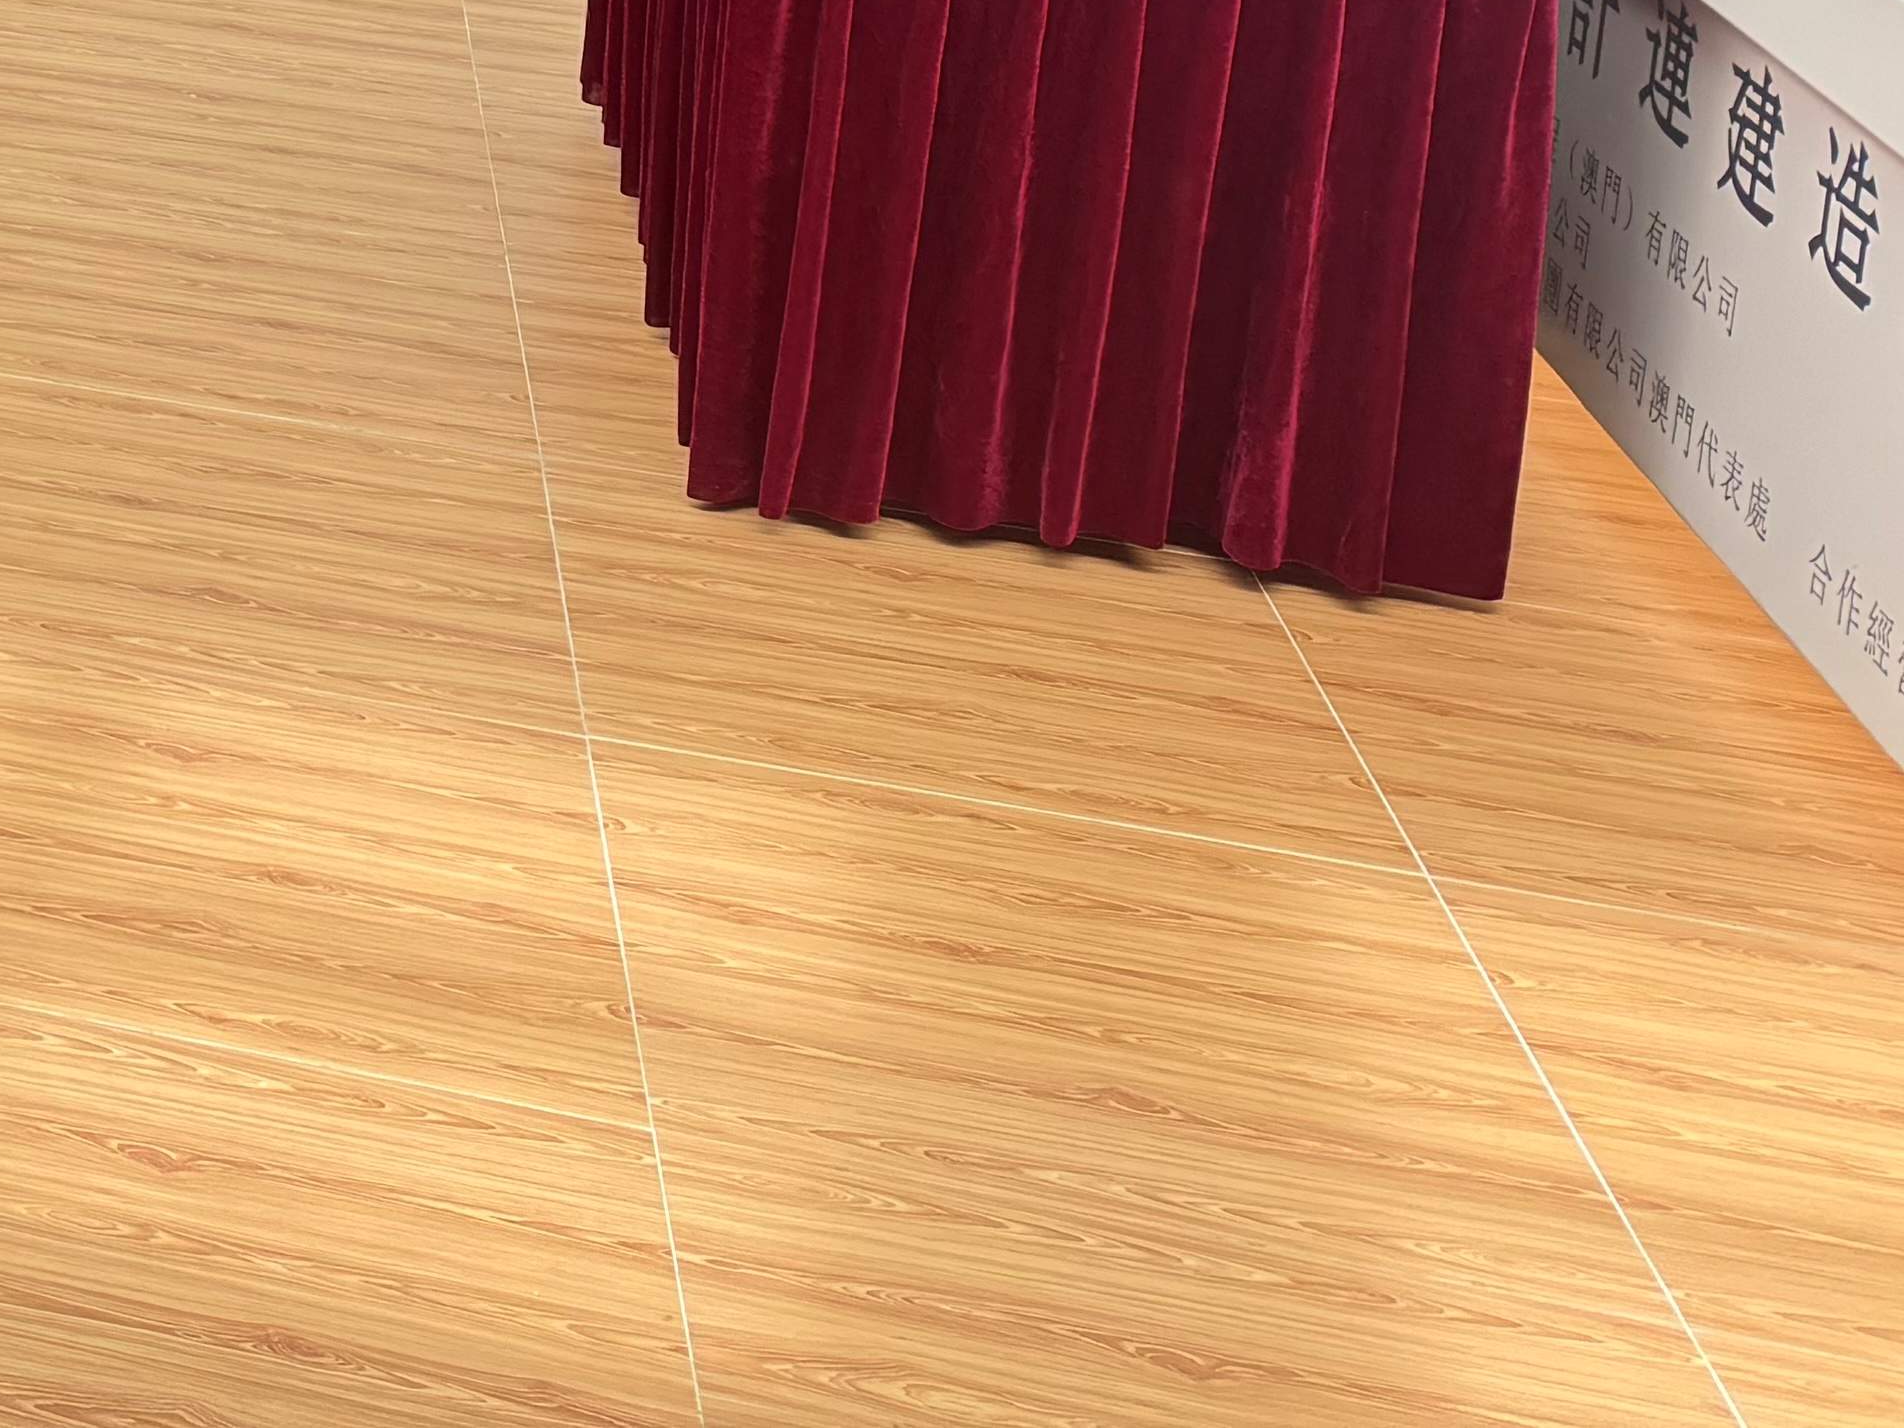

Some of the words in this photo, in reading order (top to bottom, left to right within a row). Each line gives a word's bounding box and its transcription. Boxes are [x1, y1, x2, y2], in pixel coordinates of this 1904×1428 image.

[1552, 117, 1739, 337] (澳門)有限公司
[1808, 543, 1904, 696] 合作經
